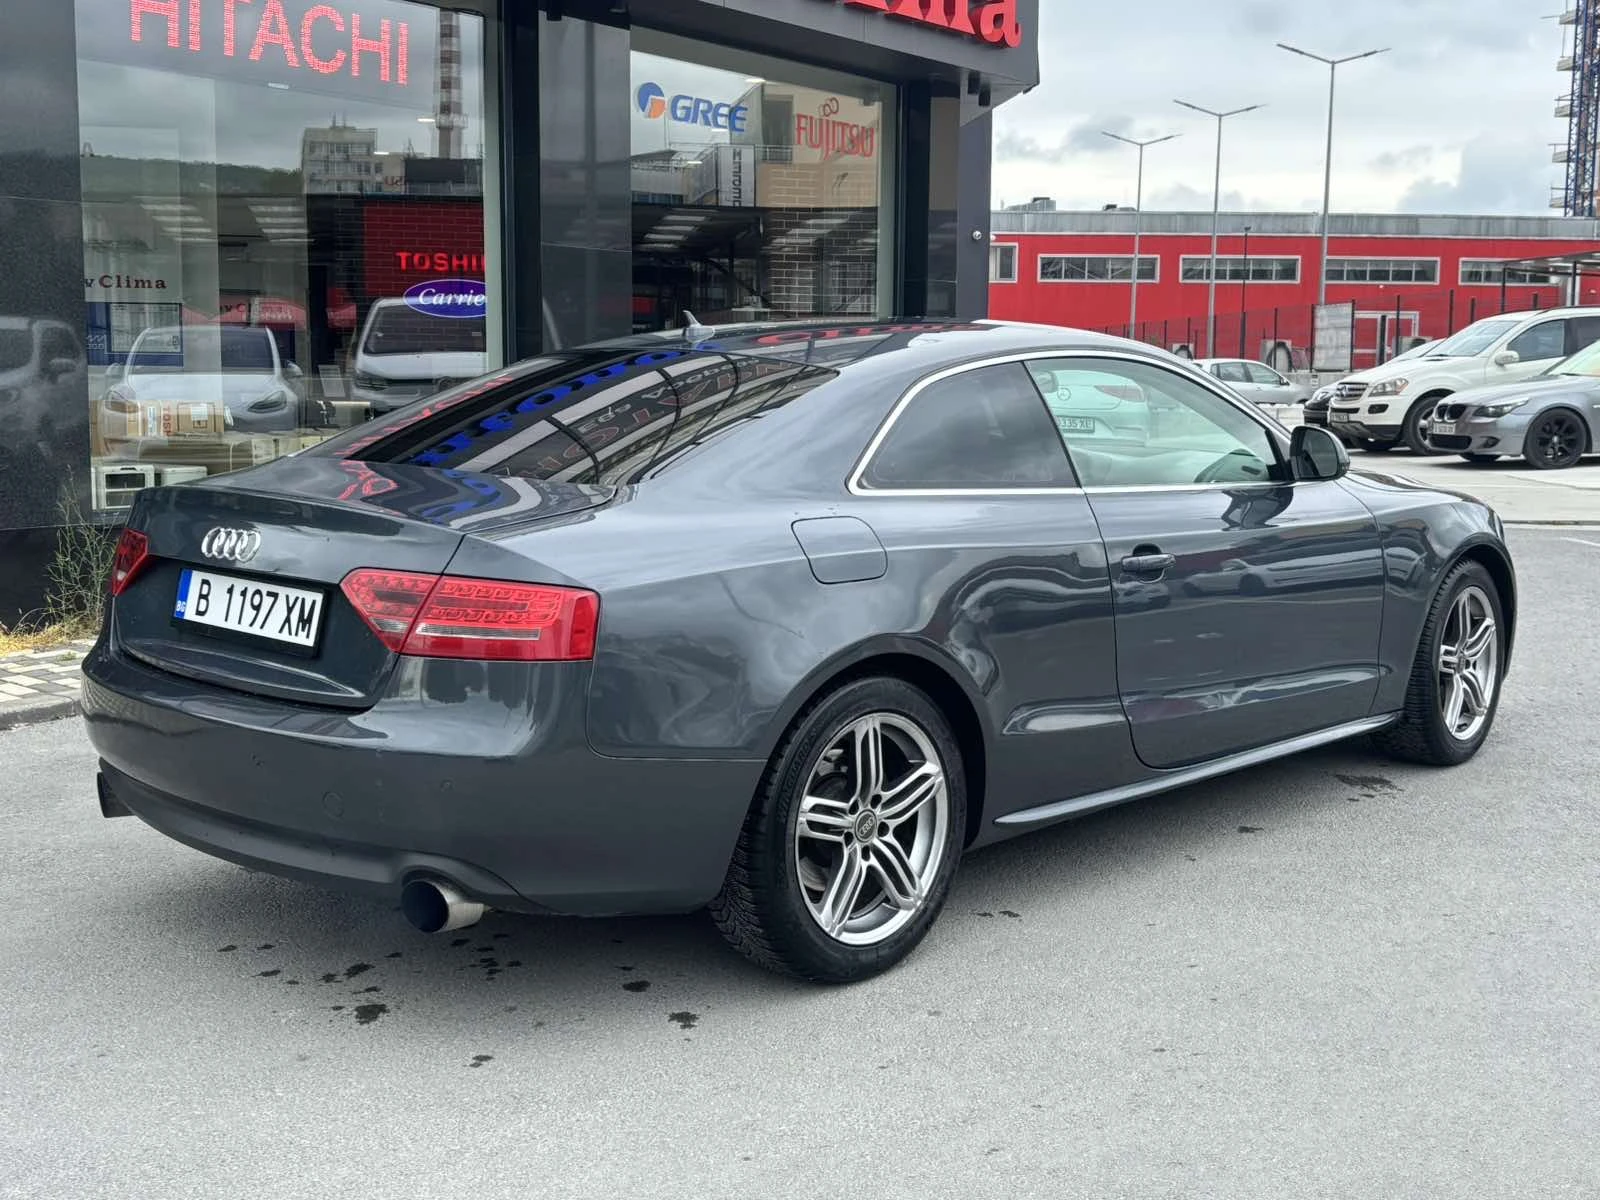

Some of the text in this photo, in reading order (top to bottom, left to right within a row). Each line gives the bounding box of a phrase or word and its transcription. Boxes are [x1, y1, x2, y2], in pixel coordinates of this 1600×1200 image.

[129, 0, 408, 85] HITACHI
[670, 94, 748, 133] GREE
[796, 113, 875, 161] FUJITSU
[396, 252, 486, 272] TOSHI
[175, 600, 188, 613] BG
